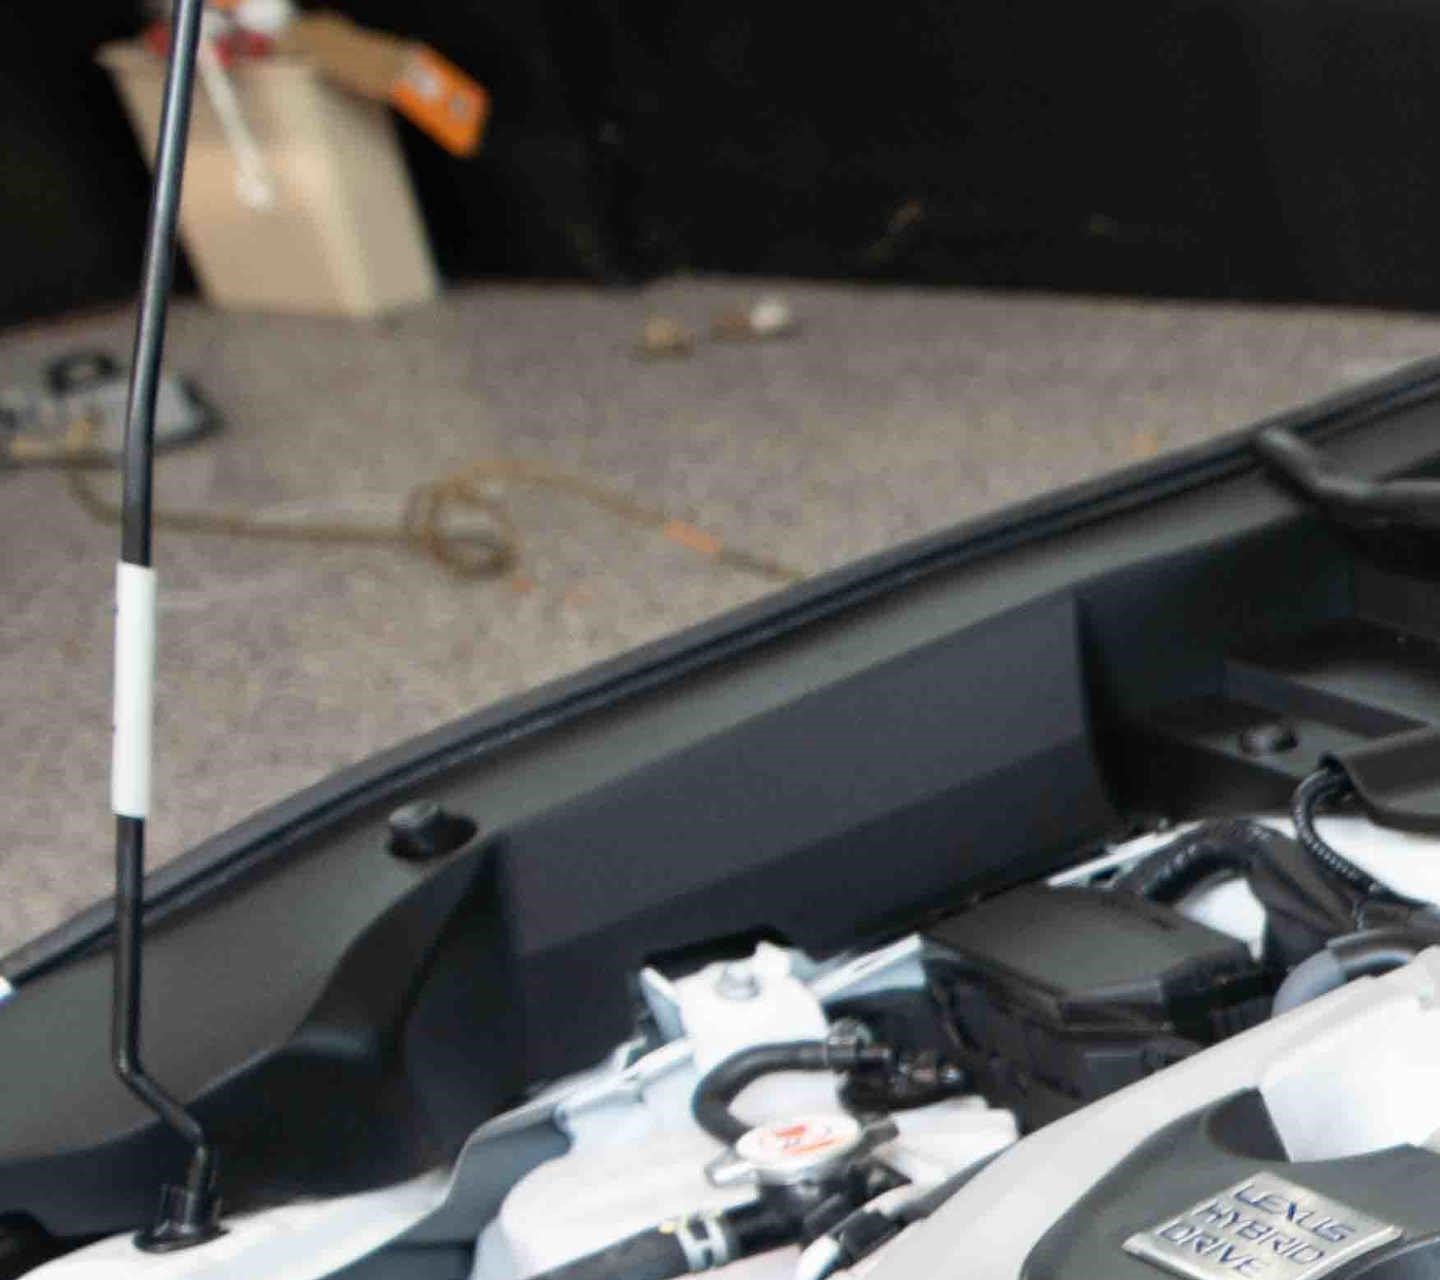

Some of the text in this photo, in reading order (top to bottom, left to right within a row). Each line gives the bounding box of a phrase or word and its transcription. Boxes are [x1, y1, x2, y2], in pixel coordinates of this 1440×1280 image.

[1193, 1202, 1326, 1264] HYBRID
[1233, 1184, 1355, 1243] LEXUS
[1157, 1221, 1267, 1274] DRIVE
